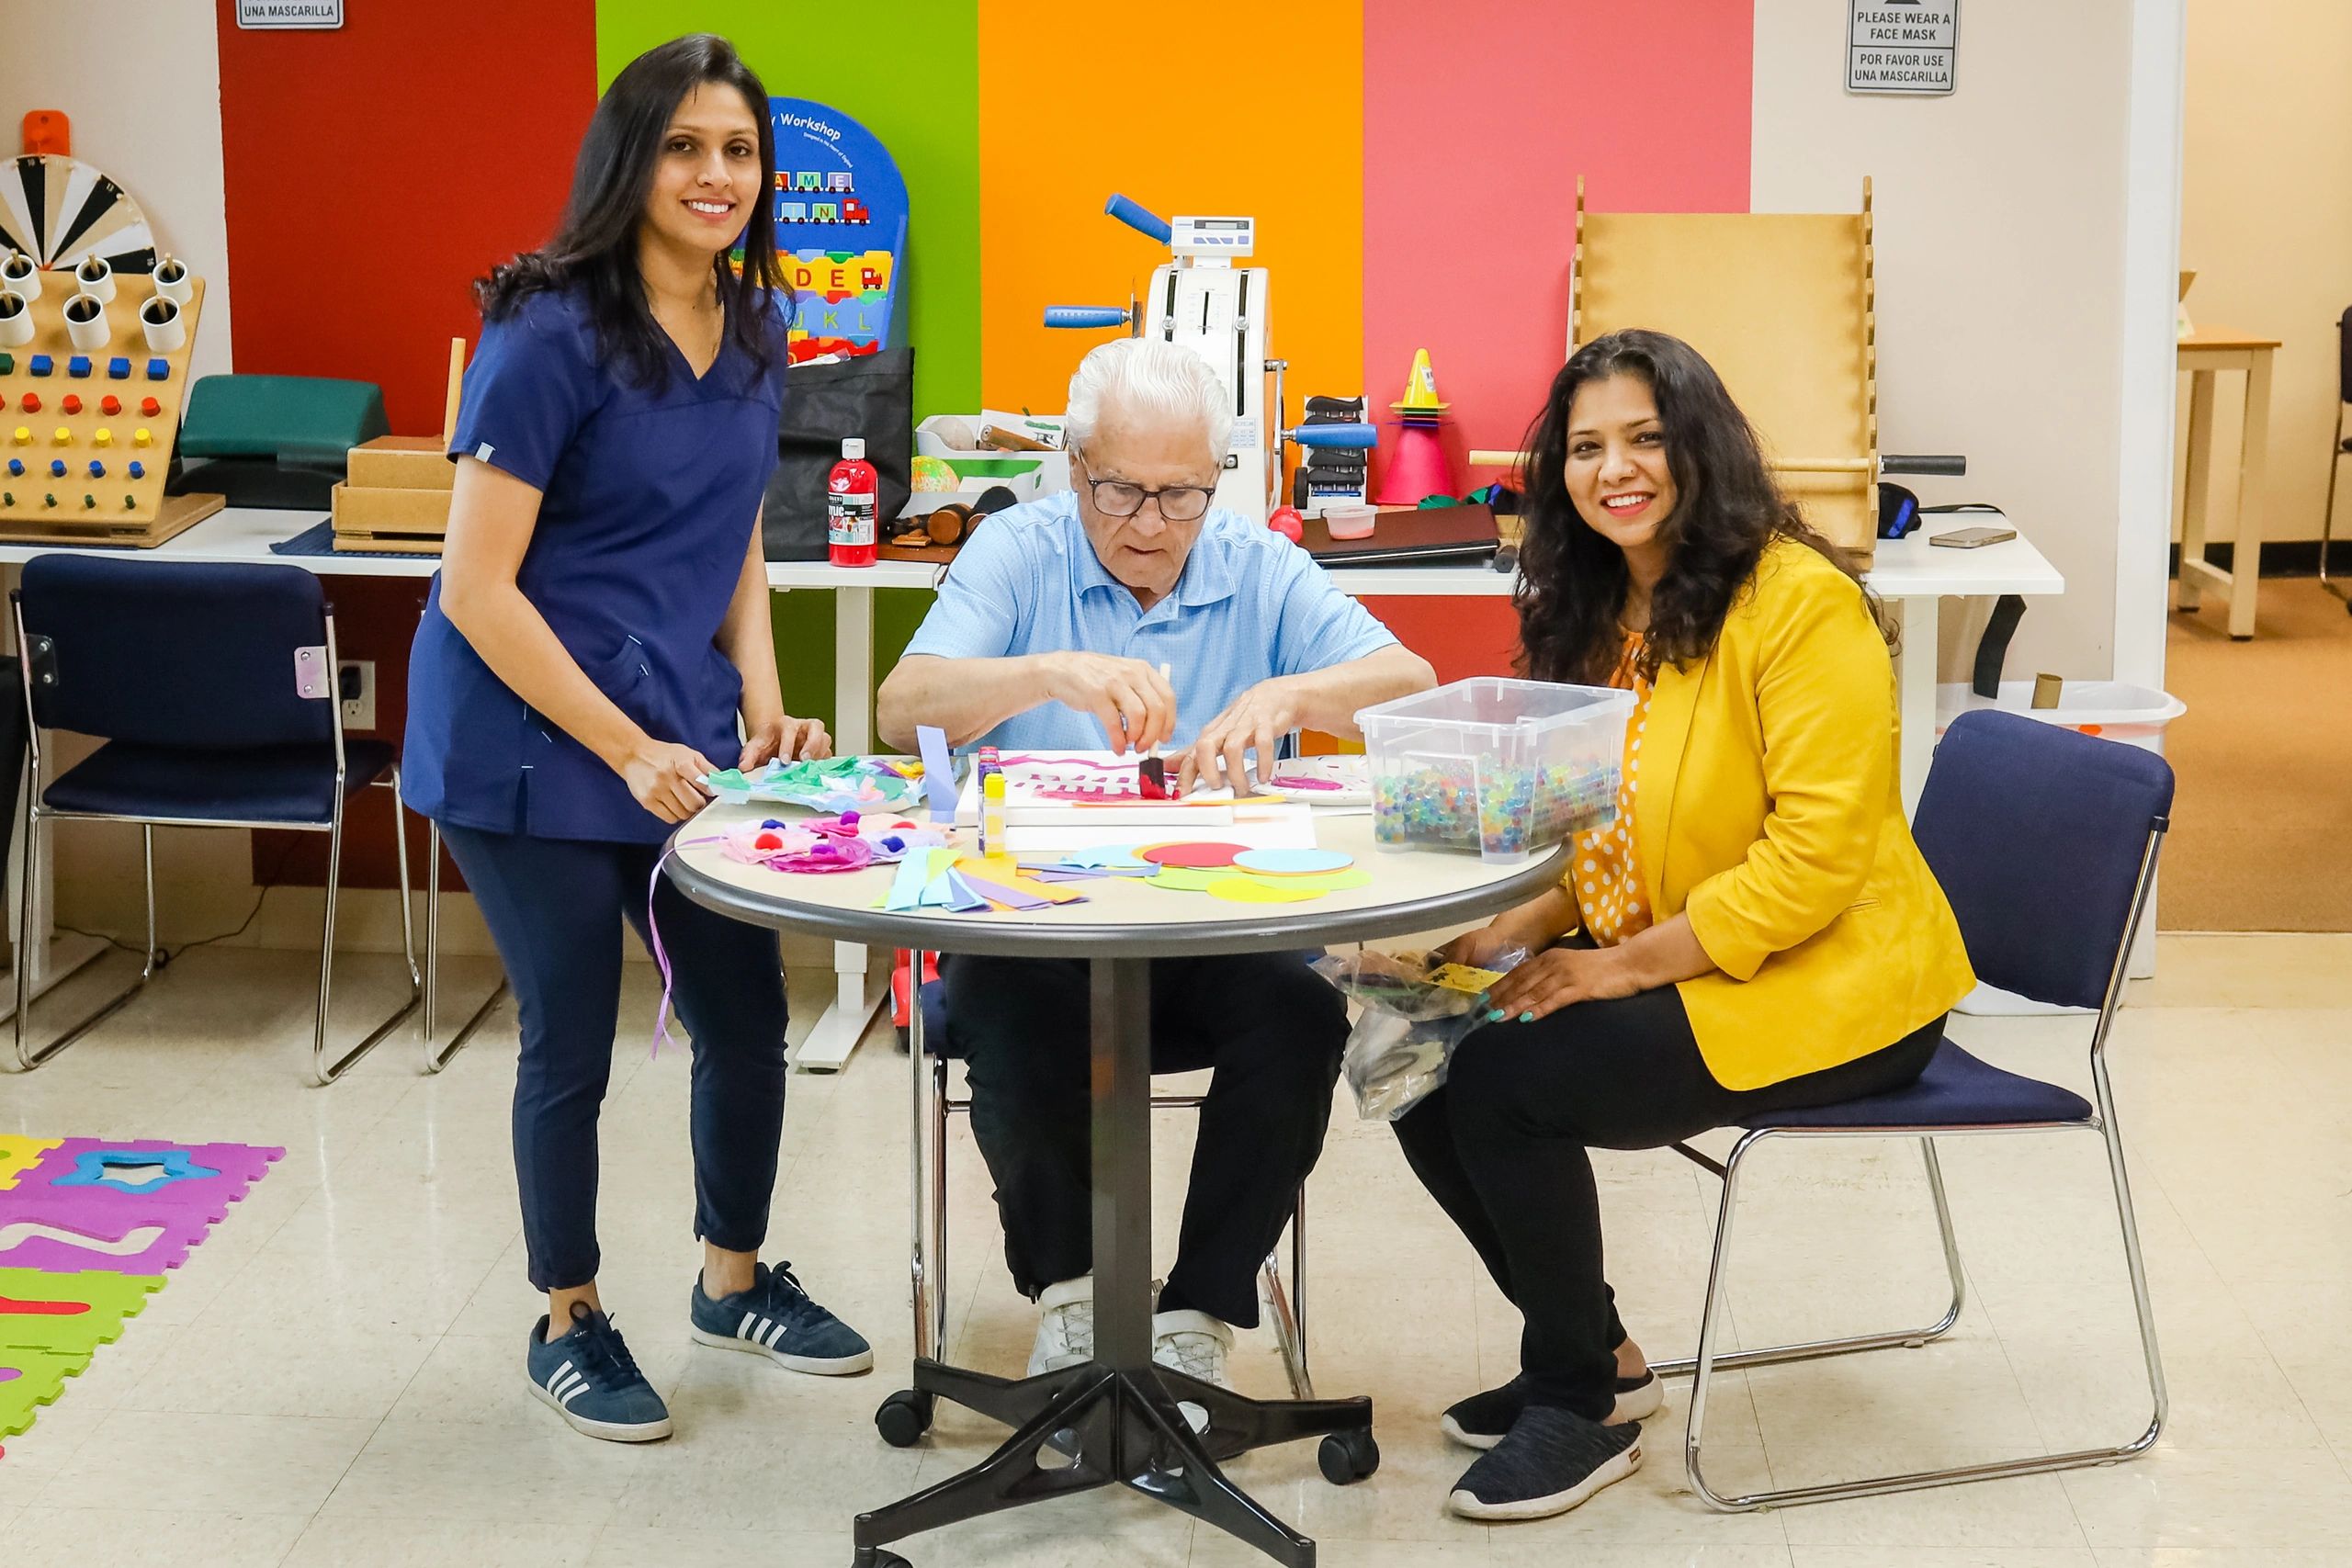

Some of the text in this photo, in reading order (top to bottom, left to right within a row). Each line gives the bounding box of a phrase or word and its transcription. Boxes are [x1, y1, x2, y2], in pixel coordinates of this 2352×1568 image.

[244, 6, 334, 17] UNA MASCARILLA
[1857, 12, 1951, 25] PLEASE WEAR A
[1870, 28, 1937, 40] FACE MASK
[1860, 53, 1944, 67] POR FAVOR USE
[1854, 70, 1948, 83] UNA MASCARILLA
[780, 113, 841, 141] Workshop
